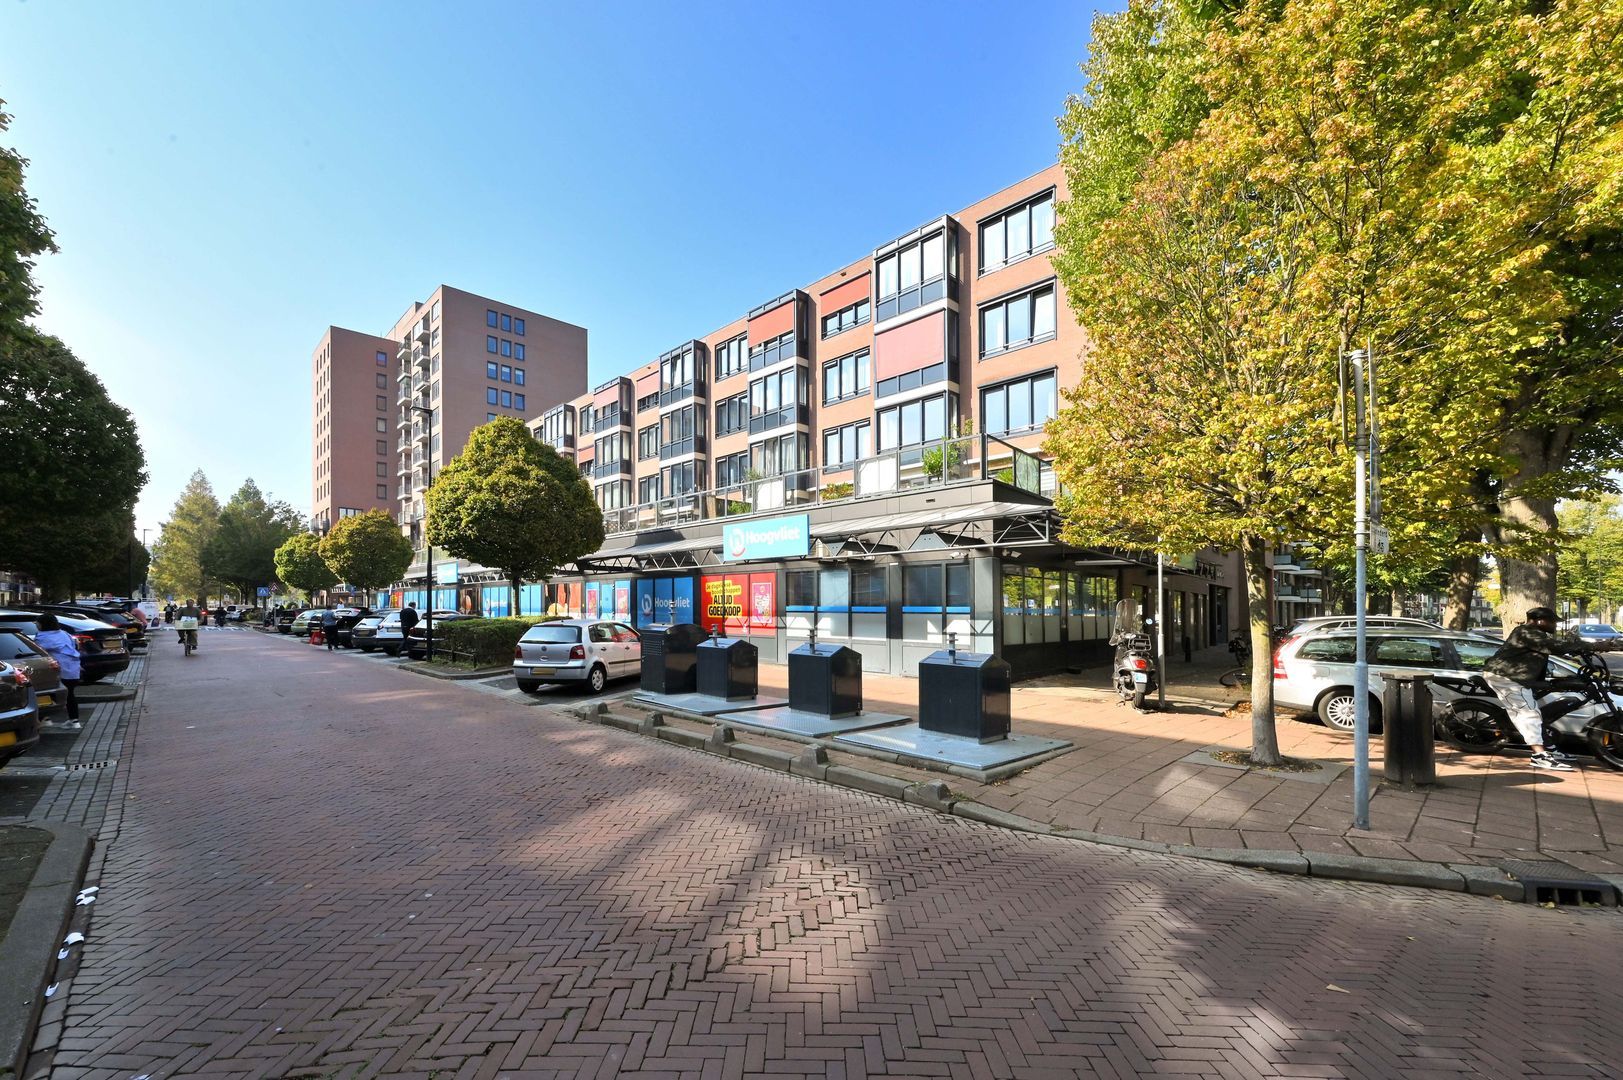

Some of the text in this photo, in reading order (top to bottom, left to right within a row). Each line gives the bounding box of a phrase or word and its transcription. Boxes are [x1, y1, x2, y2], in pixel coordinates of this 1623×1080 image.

[745, 526, 801, 545] Hoogvliet
[712, 587, 741, 595] boodhappen
[714, 595, 733, 605] ALTJD
[709, 606, 741, 617] GOEDKOOP
